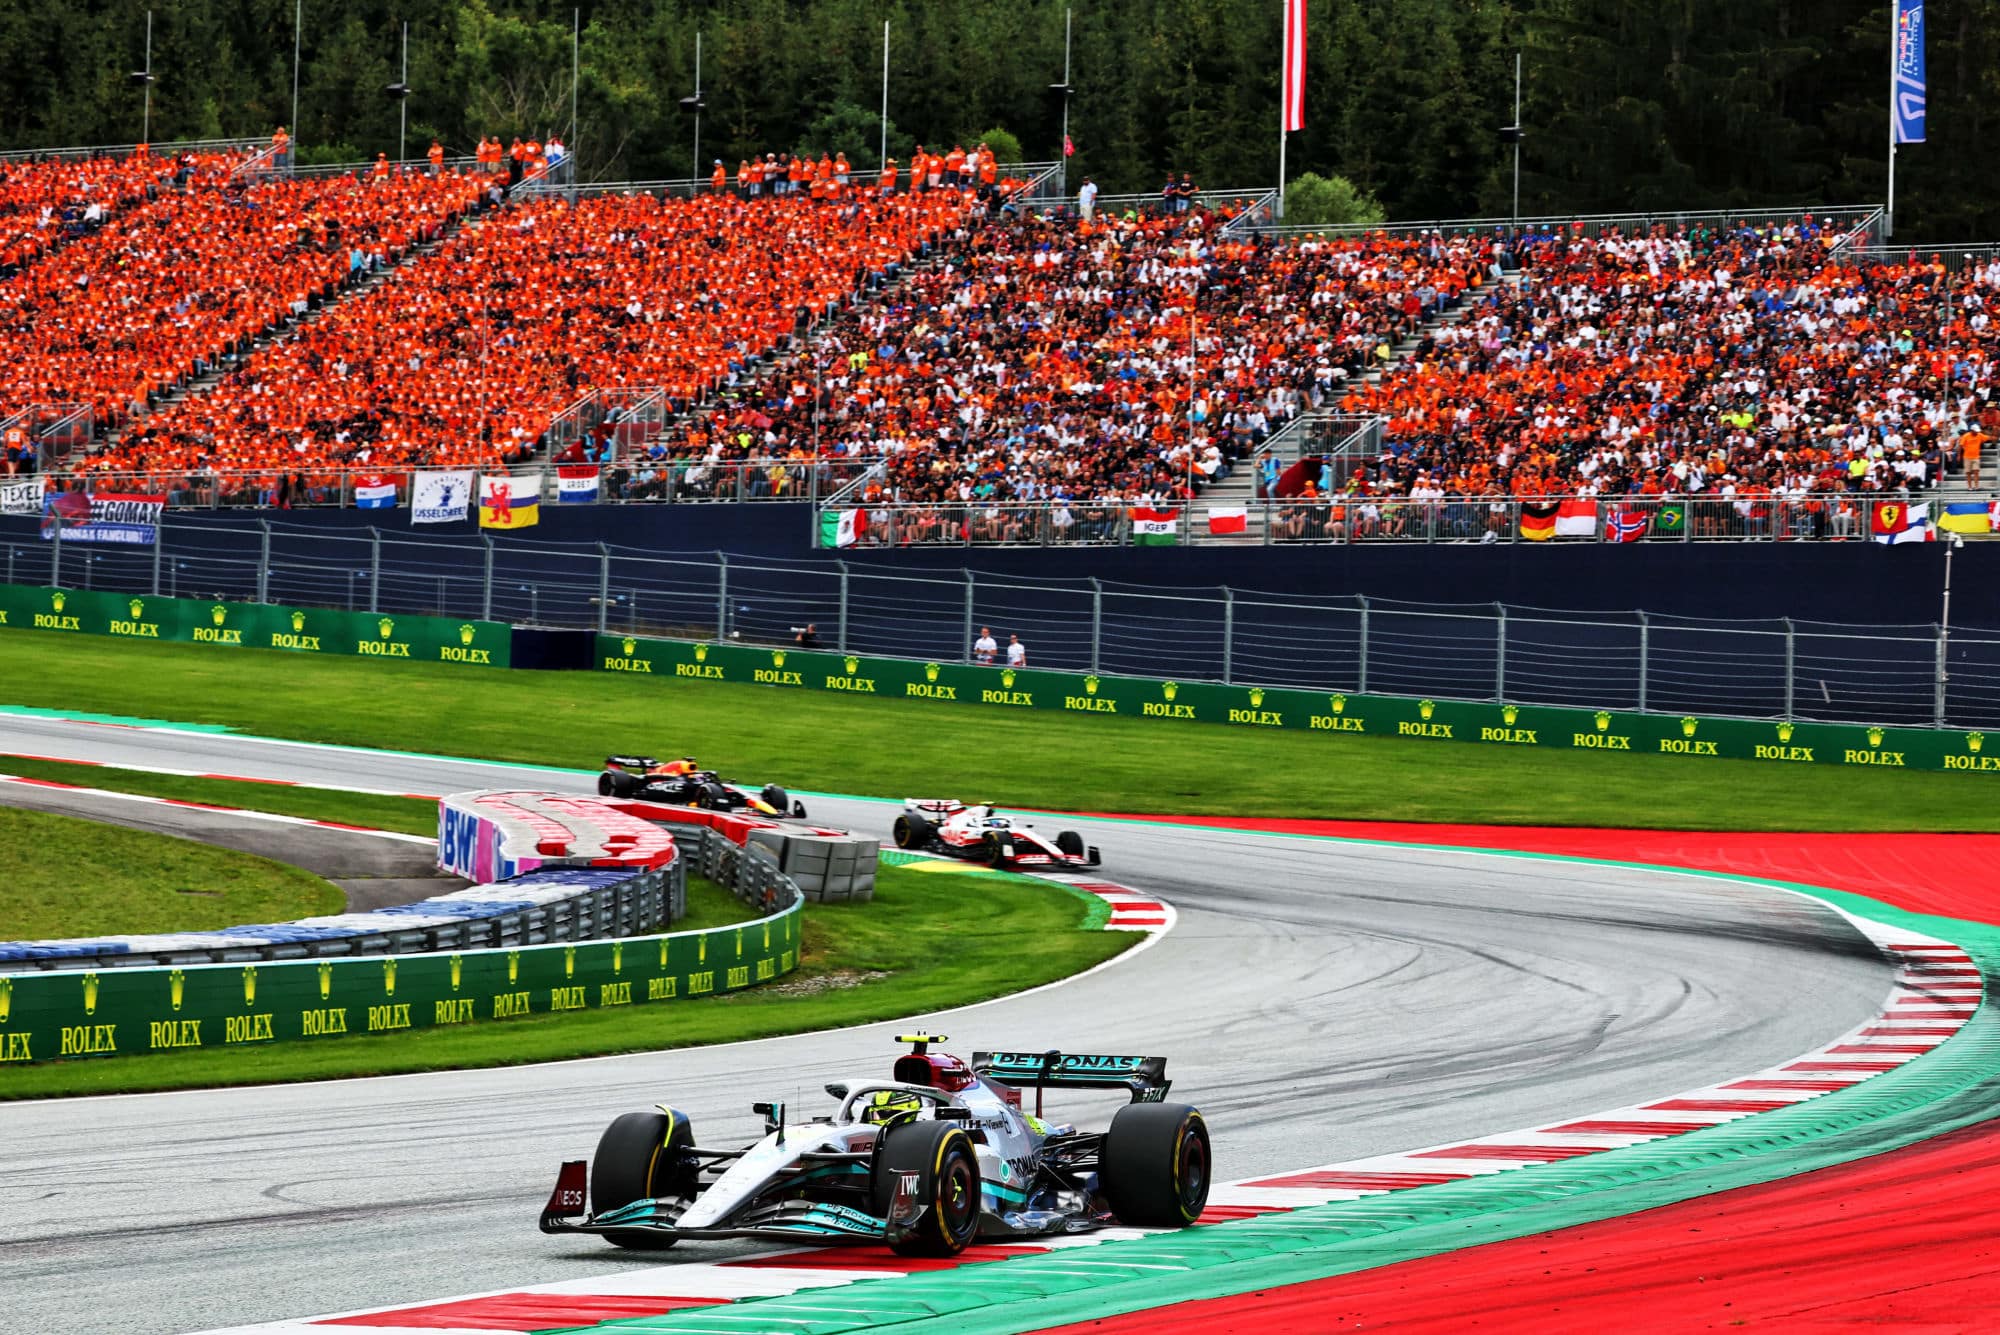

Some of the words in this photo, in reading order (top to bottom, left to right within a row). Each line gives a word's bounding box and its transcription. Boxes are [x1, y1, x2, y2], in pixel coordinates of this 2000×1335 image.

[3, 485, 41, 501] TEXEL
[34, 614, 80, 630] ROLEX
[110, 620, 159, 637] ROLEX
[193, 627, 241, 643] ROLEX
[271, 633, 320, 650] ROLEX
[358, 640, 410, 657] ROLEX
[441, 646, 490, 664] ROLEX
[605, 657, 651, 673] ROLEX
[676, 663, 724, 679] ROLEX
[754, 669, 802, 685] ROLEX
[826, 676, 875, 692] ROLEX
[906, 683, 956, 700] ROLEX
[982, 689, 1033, 706] ROLEX
[1065, 696, 1116, 713] ROLEX
[1143, 702, 1195, 719] ROLEX
[1229, 709, 1282, 726] ROLEX
[1310, 715, 1364, 732] ROLEX
[1398, 721, 1453, 738] ROLEX
[1481, 727, 1537, 744] ROLEX
[1573, 733, 1630, 750] ROLEX
[1660, 739, 1718, 755] ROLEX
[1755, 745, 1814, 762] ROLEX
[1844, 749, 1905, 766] ROLEX
[444, 808, 477, 876] BWT
[601, 981, 632, 1006] ROLEX
[648, 976, 677, 1000] ROLEX
[493, 991, 530, 1018] ROLEX
[551, 986, 586, 1011] ROLEX
[368, 1003, 411, 1031] ROLEX
[435, 998, 474, 1024] ROLEX
[225, 1013, 274, 1043] ROLEX
[302, 1008, 347, 1036] ROLEX
[60, 1024, 117, 1055] ROLEX
[150, 1020, 202, 1048] ROLEX
[0, 1032, 32, 1062] LEX
[999, 1052, 1133, 1068] PETONAS
[900, 1174, 920, 1196] IWC
